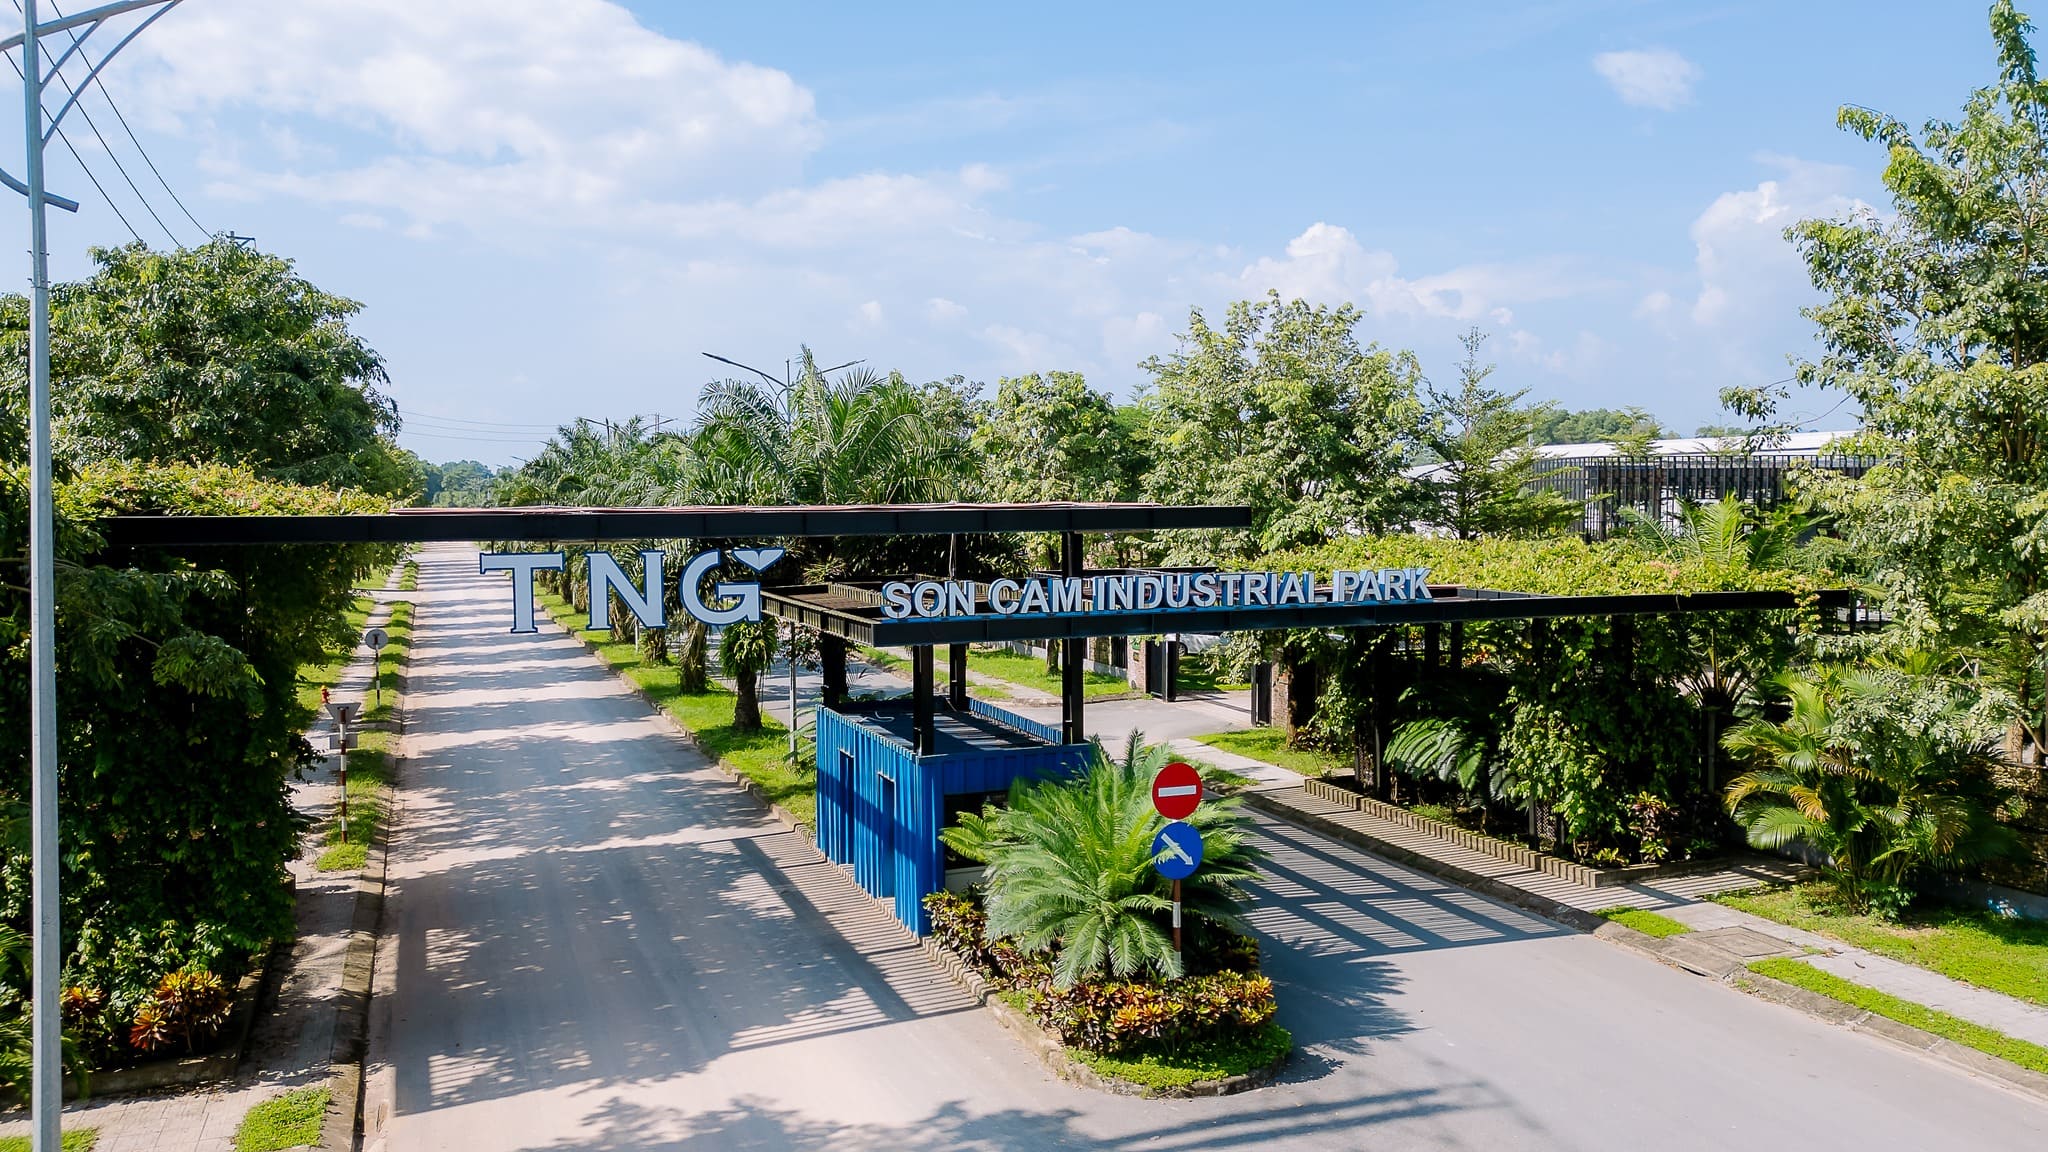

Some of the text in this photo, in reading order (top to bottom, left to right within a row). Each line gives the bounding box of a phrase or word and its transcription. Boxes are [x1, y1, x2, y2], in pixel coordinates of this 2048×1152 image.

[480, 550, 763, 633] TNG
[882, 567, 1433, 619] SON CAM INDUSTRIAL PARK
